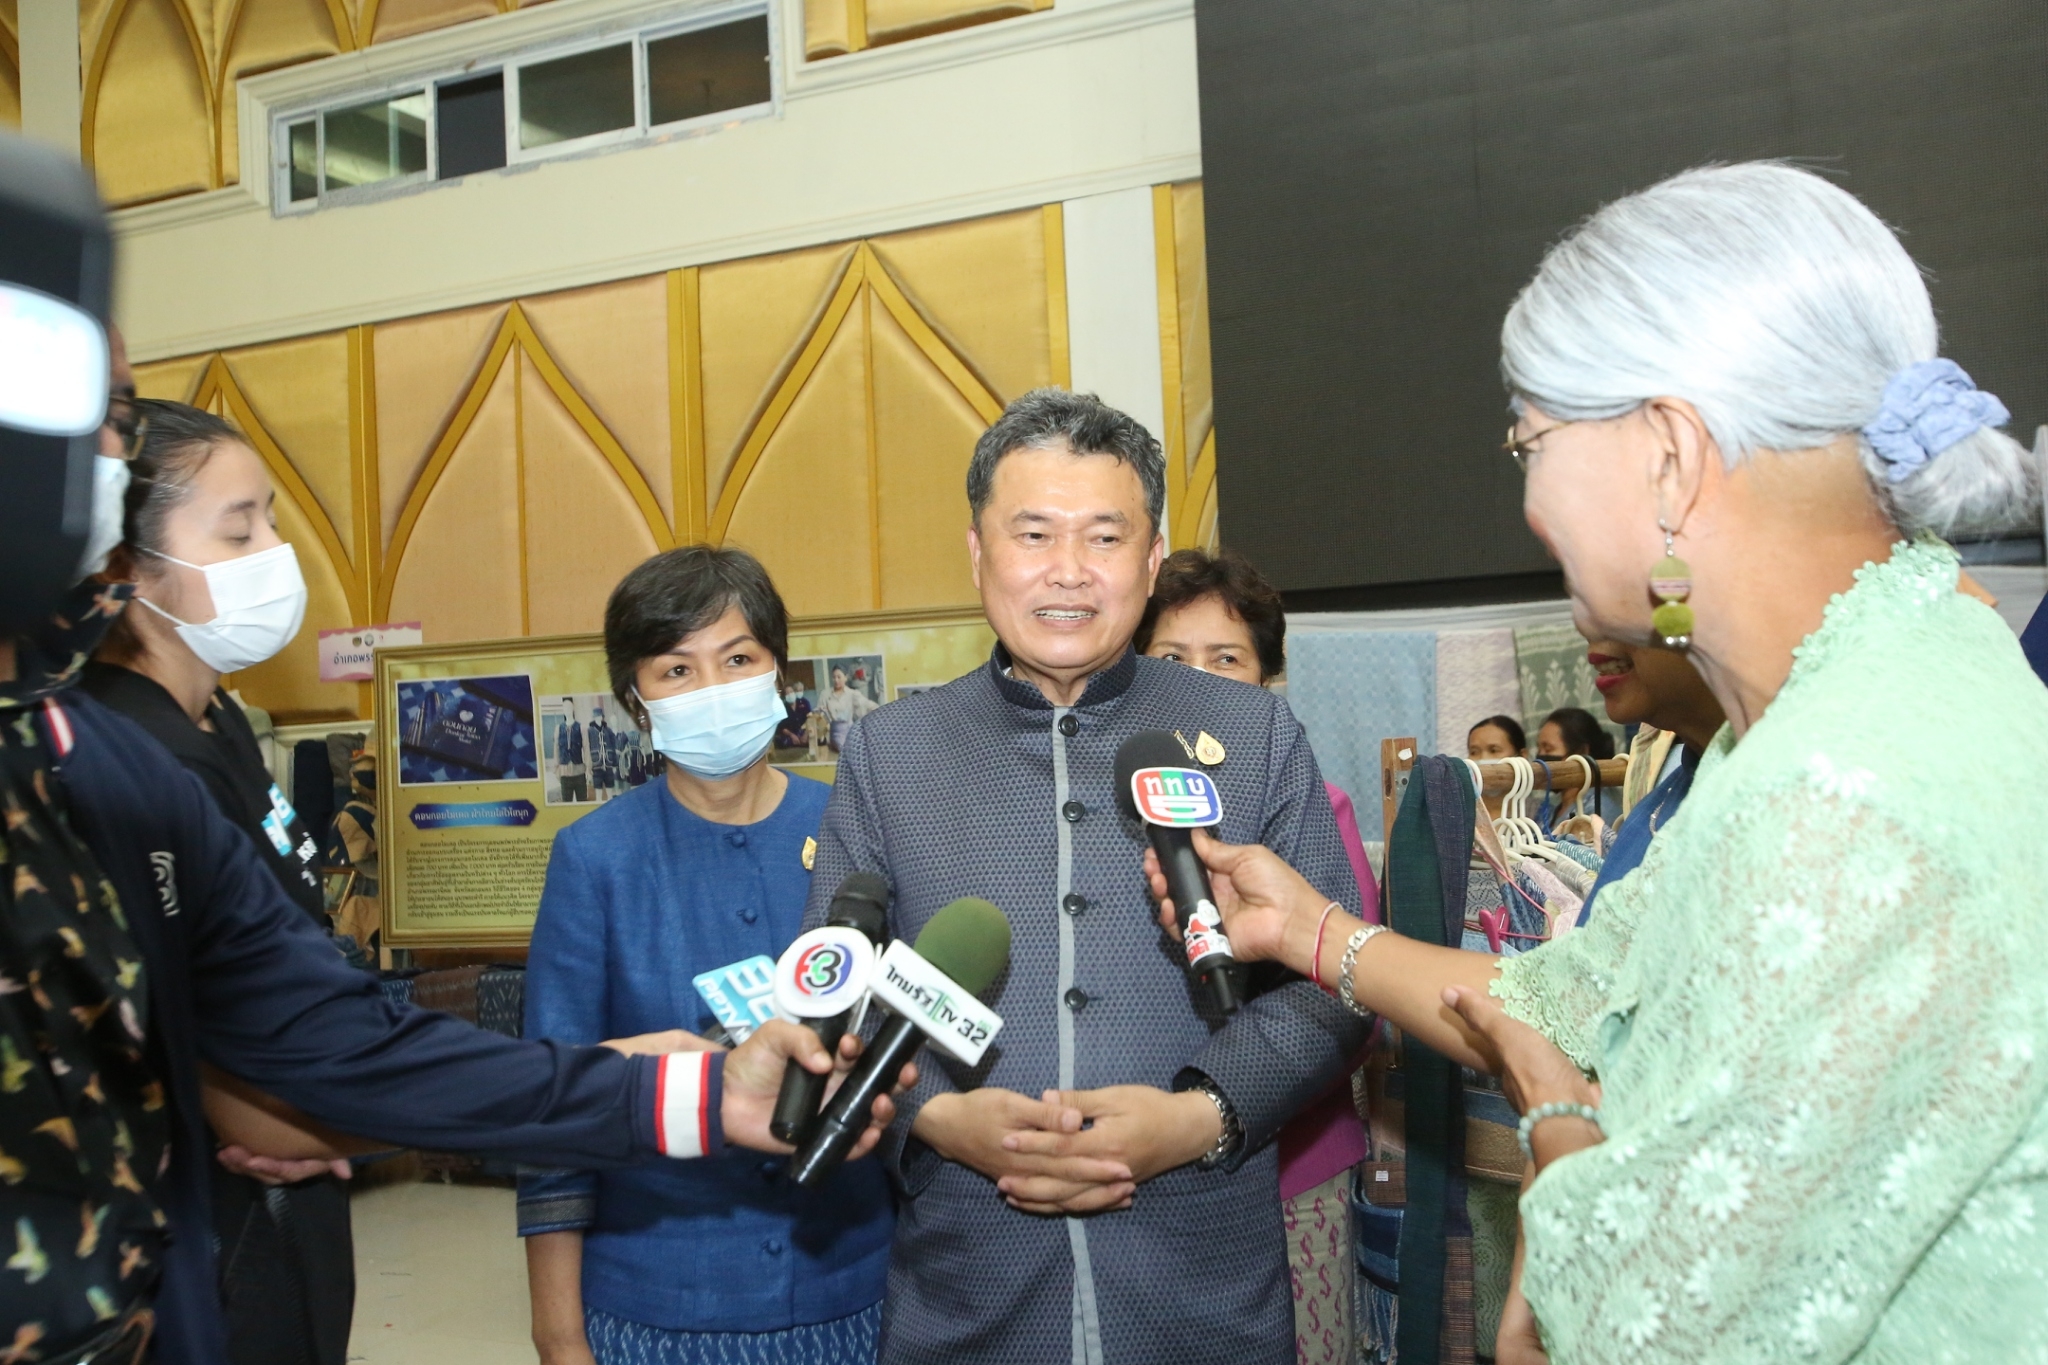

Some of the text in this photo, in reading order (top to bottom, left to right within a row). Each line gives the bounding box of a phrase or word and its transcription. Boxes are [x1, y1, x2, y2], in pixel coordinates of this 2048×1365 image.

[1143, 776, 1206, 796] ททบ
[806, 950, 842, 988] 3
[697, 977, 752, 1027] PPTV
[939, 1006, 960, 1024] TV
[956, 1017, 988, 1047] 32
